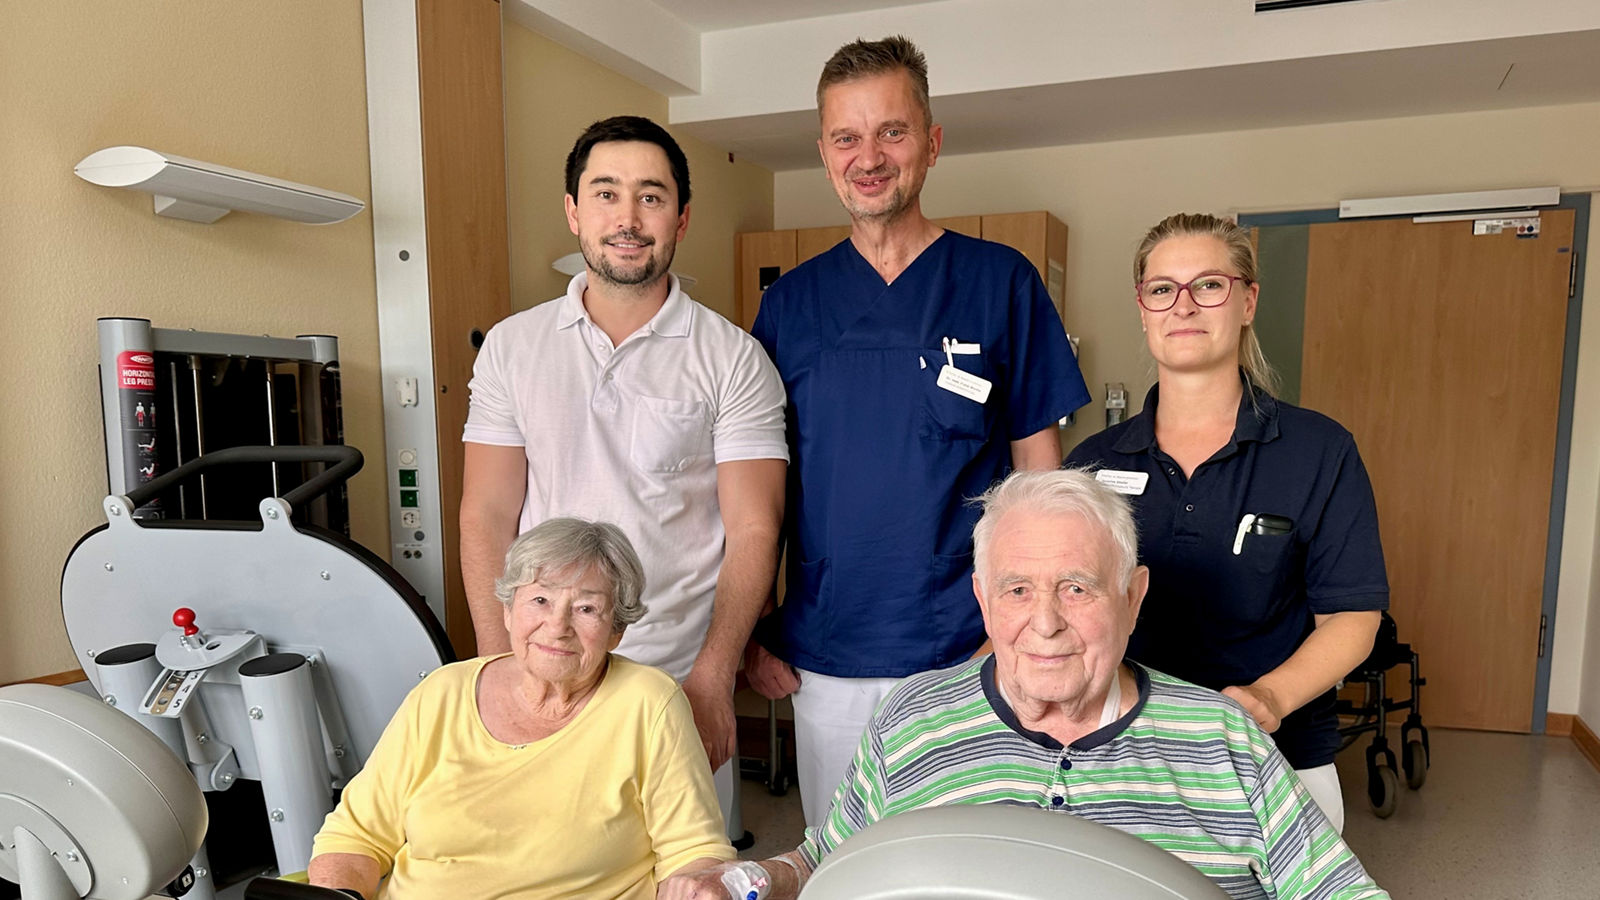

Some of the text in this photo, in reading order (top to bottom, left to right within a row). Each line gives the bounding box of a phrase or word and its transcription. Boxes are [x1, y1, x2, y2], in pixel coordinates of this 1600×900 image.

[123, 377, 136, 385] LEG
[182, 685, 191, 693] 4
[173, 699, 182, 708] 5
